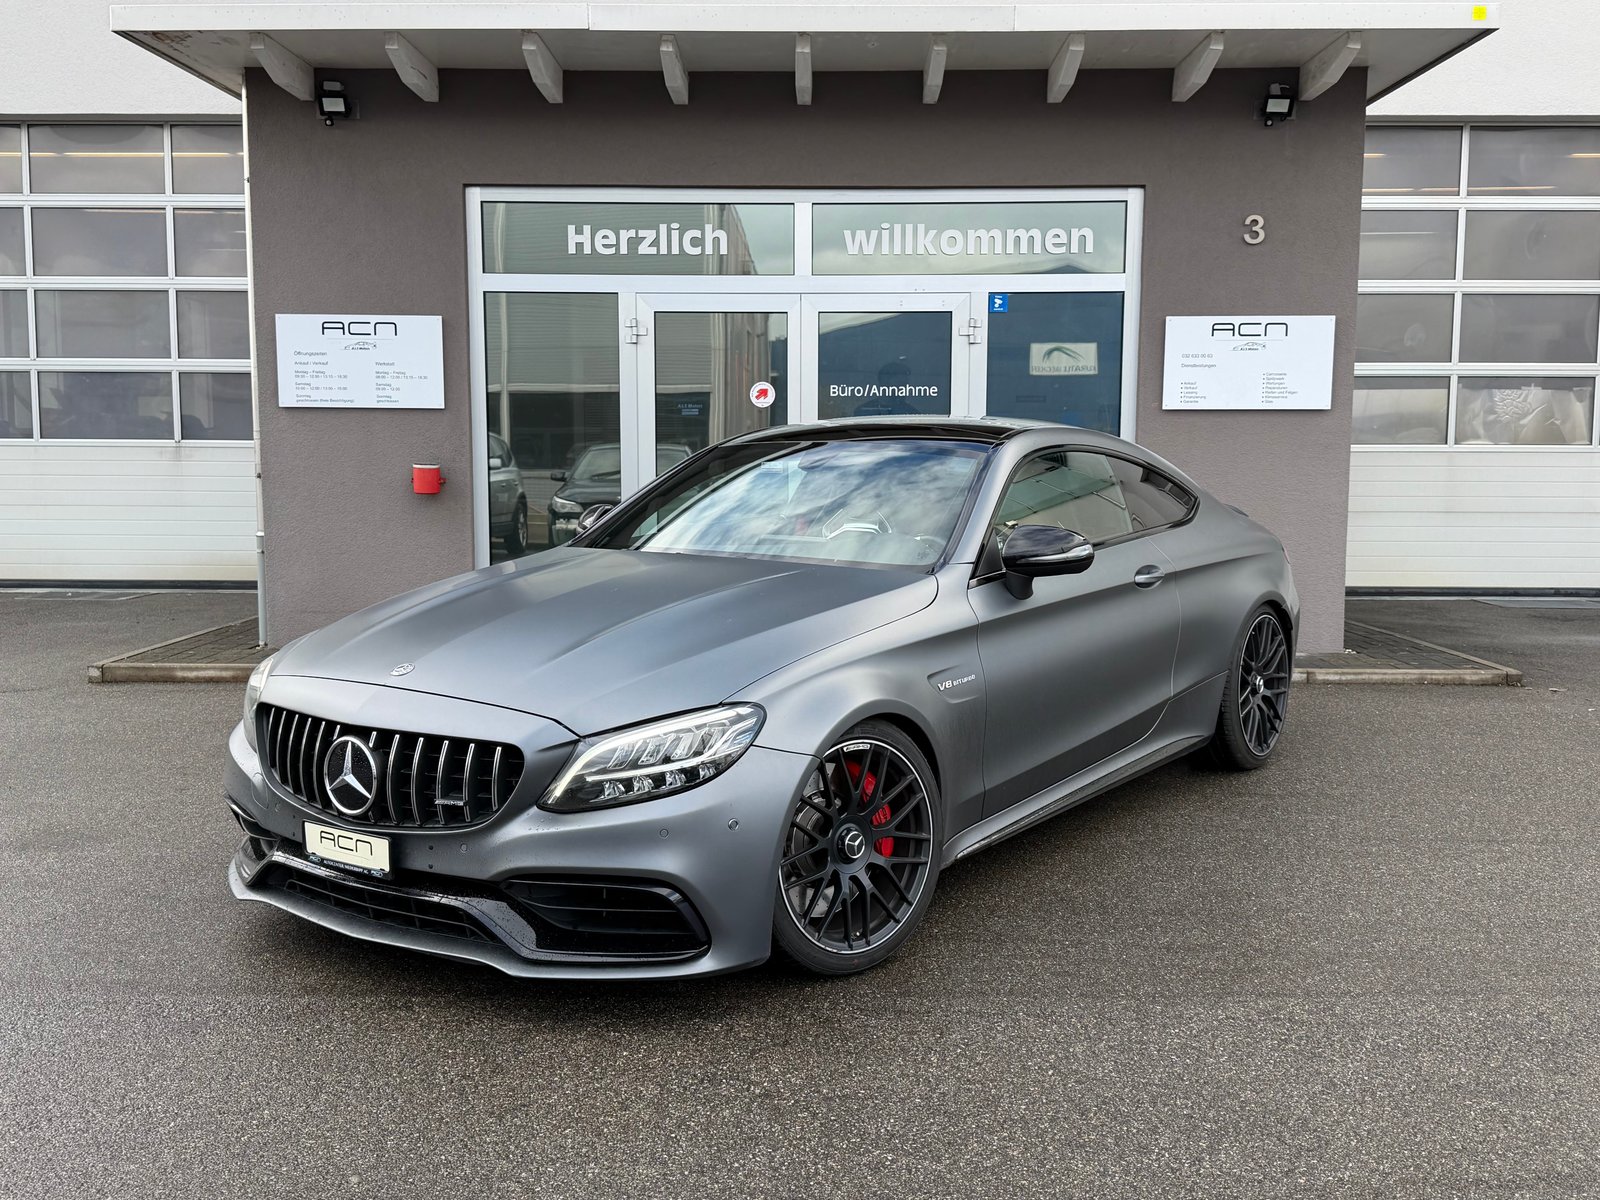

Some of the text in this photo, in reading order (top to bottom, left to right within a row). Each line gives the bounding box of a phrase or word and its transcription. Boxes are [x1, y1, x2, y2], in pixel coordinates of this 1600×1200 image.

[1243, 214, 1265, 245] 3
[567, 222, 1094, 255] Herzlich willkommen
[322, 321, 397, 336] ACN
[1211, 322, 1288, 337] ACN
[830, 384, 938, 397] Büro/Annahme
[937, 674, 976, 691] V8 BITURBO
[320, 830, 373, 856] ACN
